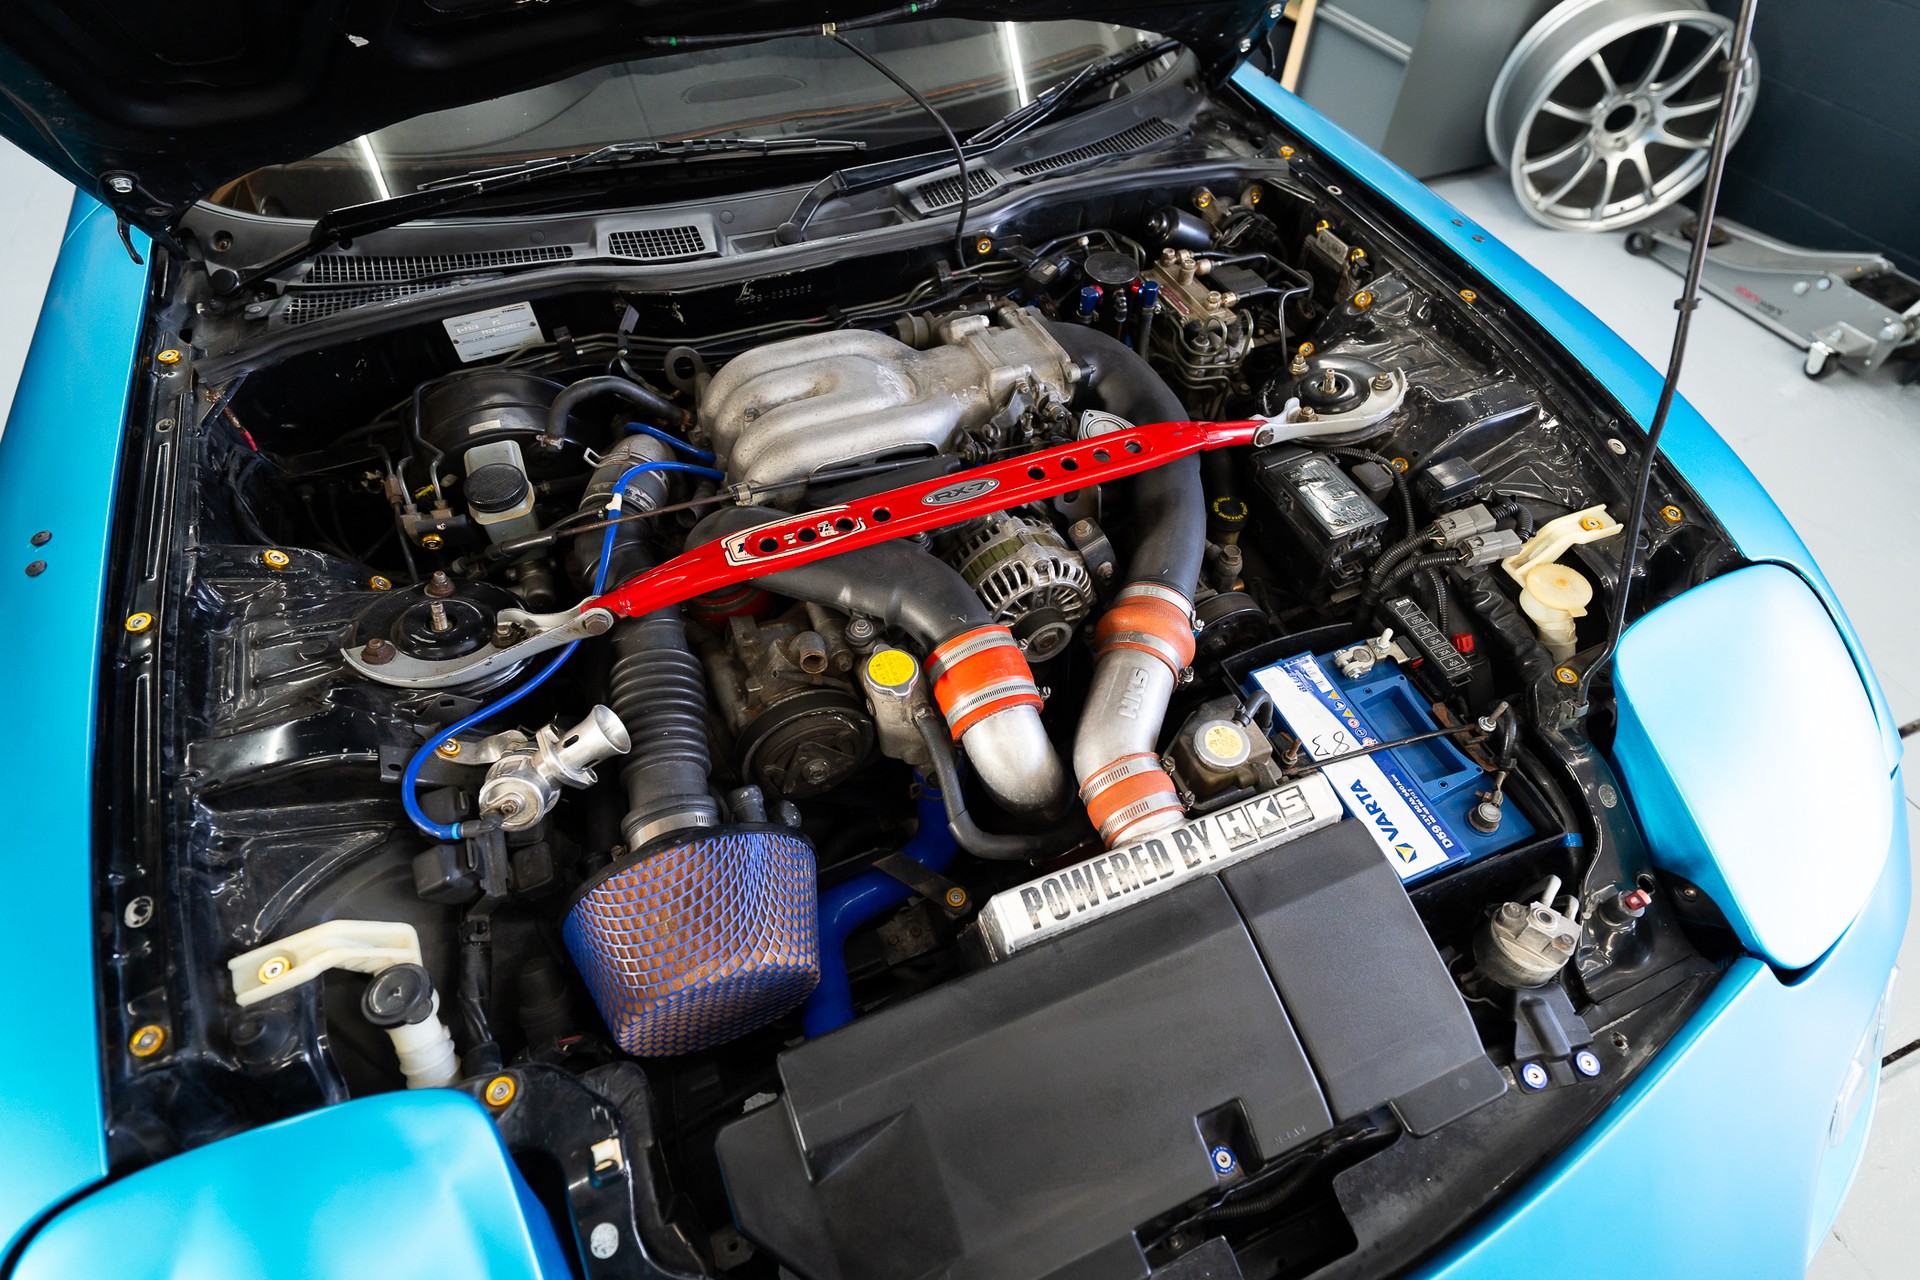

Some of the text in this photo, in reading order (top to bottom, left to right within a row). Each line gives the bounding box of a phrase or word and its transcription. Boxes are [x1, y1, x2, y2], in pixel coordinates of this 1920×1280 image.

[934, 481, 987, 502] RX-7
[1118, 667, 1149, 719] HKS
[1350, 778, 1399, 842] VARTA
[1420, 814, 1432, 826] 12V
[1431, 824, 1455, 849] D59
[1019, 785, 1315, 930] POWERED BY HKS
